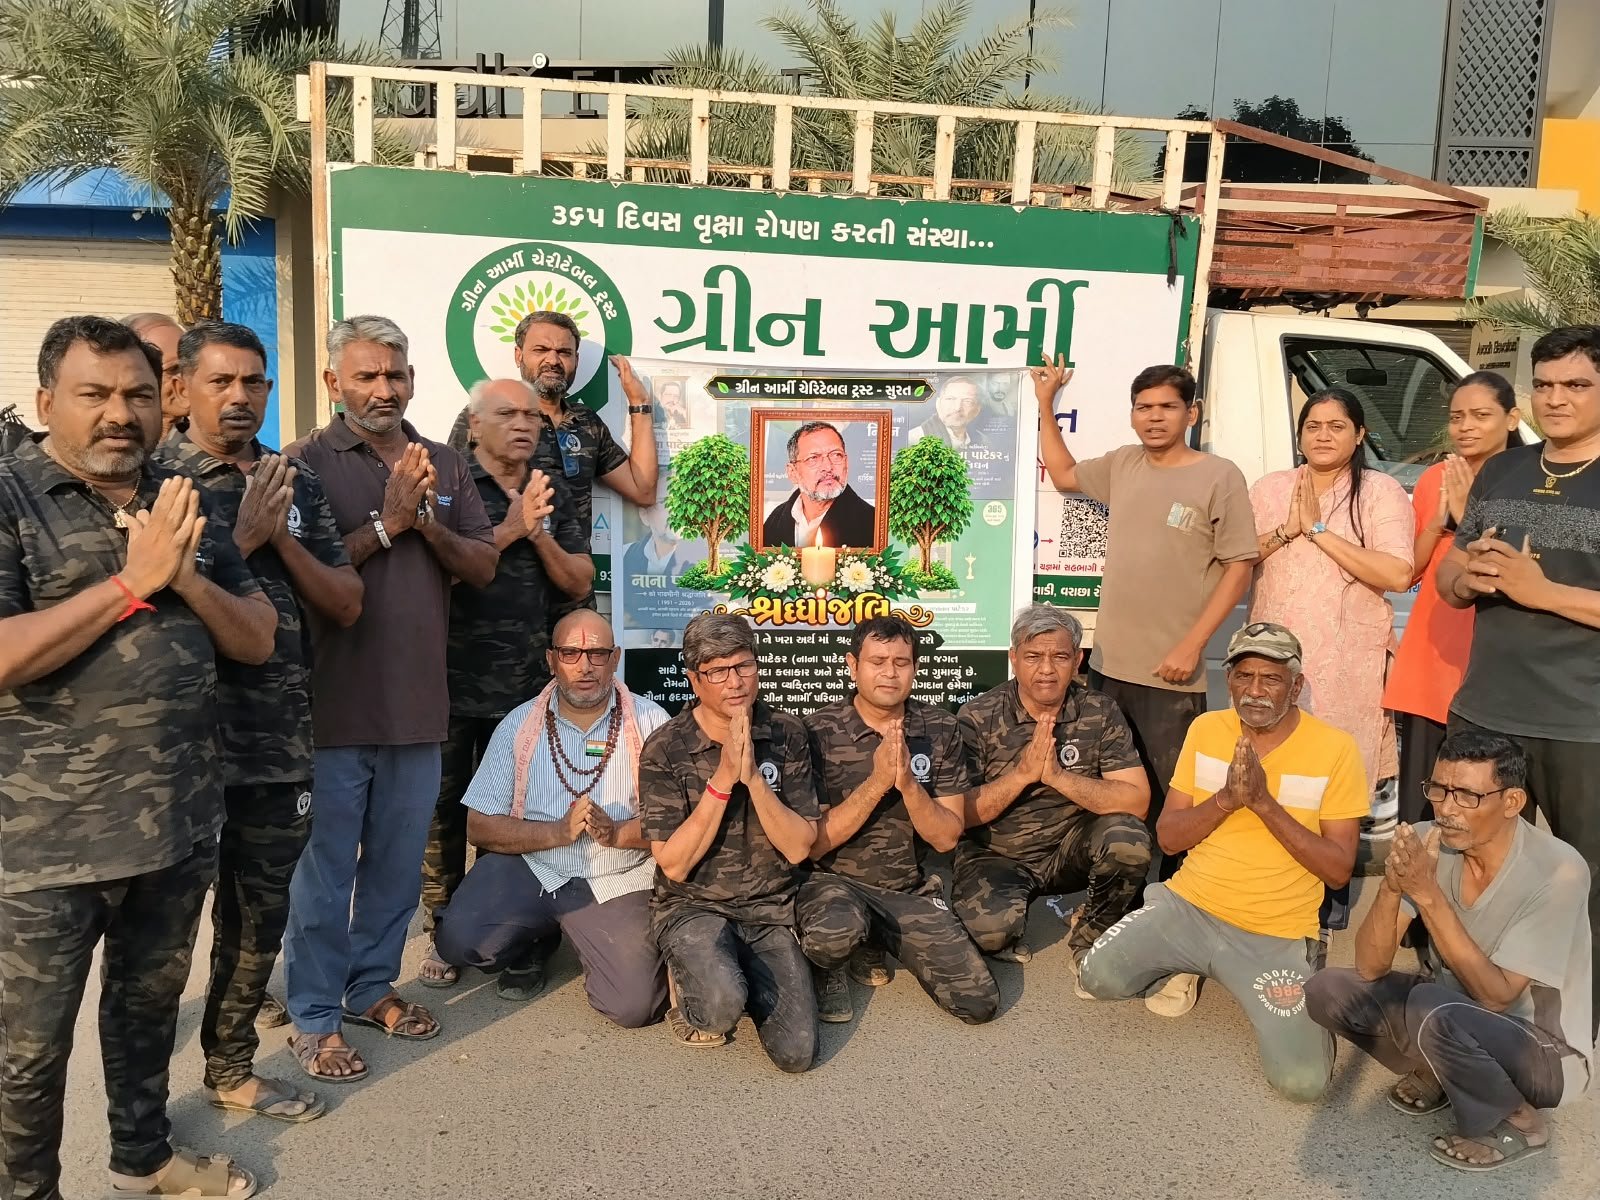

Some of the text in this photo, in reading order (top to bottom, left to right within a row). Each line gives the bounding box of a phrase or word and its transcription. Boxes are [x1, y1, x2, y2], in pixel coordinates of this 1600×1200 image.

[617, 201, 681, 232] દિવસ
[693, 214, 744, 244] વૃક્ષા
[755, 209, 820, 241] રોપણ
[831, 218, 895, 245] કરતી
[461, 279, 487, 312] ગ્રીન
[486, 250, 525, 280] આર્મી
[592, 290, 618, 321] ટ્રસ્ટ
[652, 264, 1089, 369] ગ્રીન આર્મી
[735, 379, 760, 395] ગ્રીન
[764, 380, 796, 395] આર્મી
[798, 380, 848, 396] ચેરિટેબલ
[851, 385, 873, 399] ટ્રસ્ટ
[885, 385, 912, 400] સુરત
[988, 505, 1002, 513] 365
[630, 574, 668, 588] नाना
[1060, 586, 1091, 597] વરાછા
[775, 636, 793, 644] ખરા
[796, 633, 816, 644] અર્થ
[818, 633, 829, 644] માં
[758, 653, 788, 663] પાટેકર
[822, 653, 846, 663] પાટેક
[933, 655, 959, 664] જગત
[658, 664, 677, 675] સાથે
[775, 668, 810, 677] કલાકાર
[814, 666, 832, 677] અને
[663, 677, 689, 688] તેમનો
[826, 679, 844, 690] અને
[947, 679, 972, 690] હંમેશા
[763, 692, 783, 703] ગ્રીન
[786, 692, 813, 702] આર્મી
[1271, 978, 1292, 987] NYC
[1265, 984, 1301, 998] 1982
[1258, 994, 1290, 1017] SPORTING
